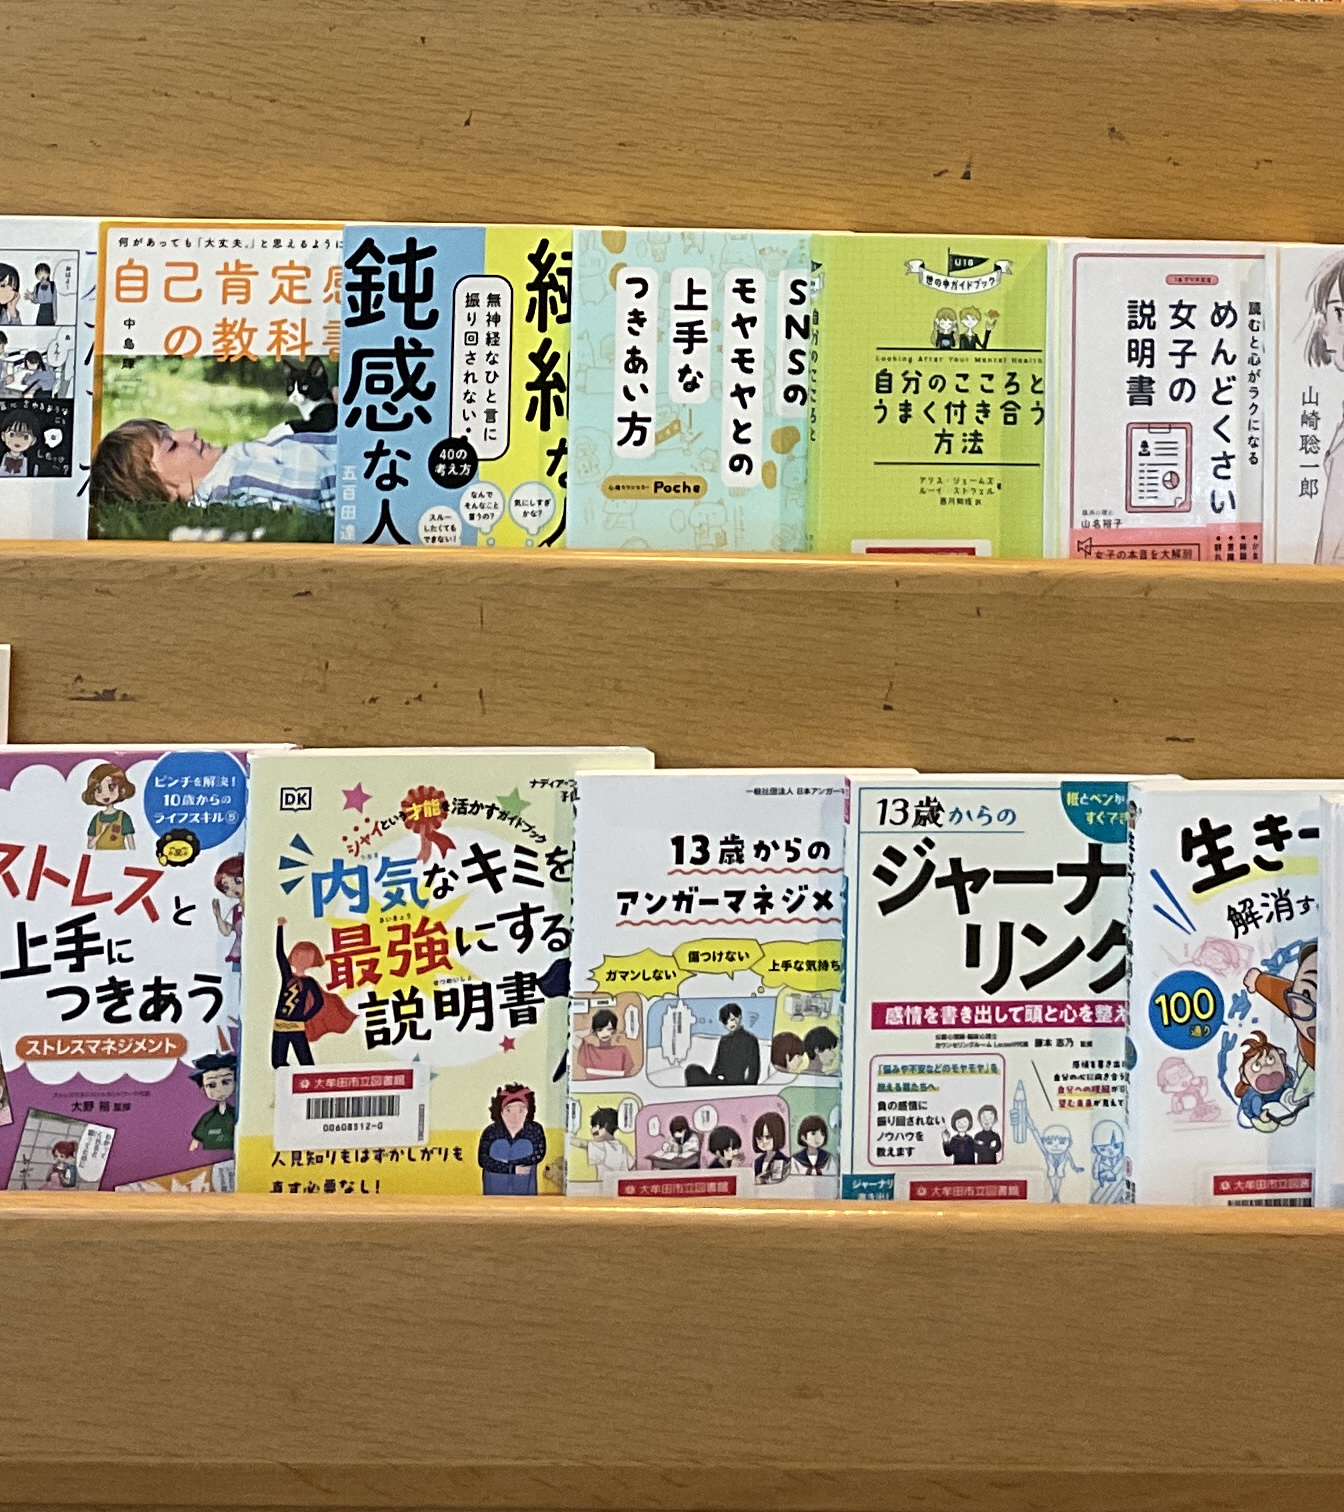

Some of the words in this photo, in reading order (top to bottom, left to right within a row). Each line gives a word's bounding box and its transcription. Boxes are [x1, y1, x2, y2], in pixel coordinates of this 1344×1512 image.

[672, 277, 708, 393] 上手な
[782, 278, 811, 406] SNSの
[483, 292, 502, 441] 無神経なひと言に
[616, 276, 653, 448] つきあい方
[1126, 299, 1157, 407] 説明書
[1168, 300, 1198, 403] 女子の
[342, 236, 440, 546] 鈍感な人
[727, 276, 758, 476] モヤモヤとの
[874, 369, 1044, 396] 自分のこころと
[1247, 301, 1262, 466] 読むと心がラクになる
[873, 400, 1045, 427] うまく付き合う
[1210, 300, 1239, 515] めんどくさい
[439, 448, 468, 460] 40の
[933, 429, 985, 455] 方法
[434, 463, 472, 476] 考え方
[470, 491, 493, 499] なんで
[653, 479, 701, 494] Poche
[464, 501, 499, 510] そんなこと
[163, 792, 231, 807] 10歳からの
[285, 792, 307, 805] DK
[875, 795, 1017, 829] 13歳からの
[670, 834, 832, 865] 13歳からの
[311, 842, 572, 918] 内気なキミを
[872, 835, 1127, 917] ジャーナ
[616, 885, 835, 917] アンガーマネジメ
[0, 911, 135, 979] 上手に
[324, 902, 574, 992] 最強にする
[687, 950, 750, 964] 傷つけない
[605, 967, 677, 982] ガマンしない
[767, 958, 841, 973] 上手な気持ち
[46, 973, 224, 1024] つきあう
[357, 970, 546, 1051] 説明書
[1154, 988, 1215, 1027] 100
[25, 1038, 177, 1056] ストレスマネジメント
[876, 1116, 946, 1126] 振り回されない
[877, 1100, 928, 1111] 負の感情に
[876, 1131, 924, 1142] ノウハウを
[876, 1147, 915, 1157] 教えます
[271, 1146, 464, 1167] 人見知りもはずかしがりも
